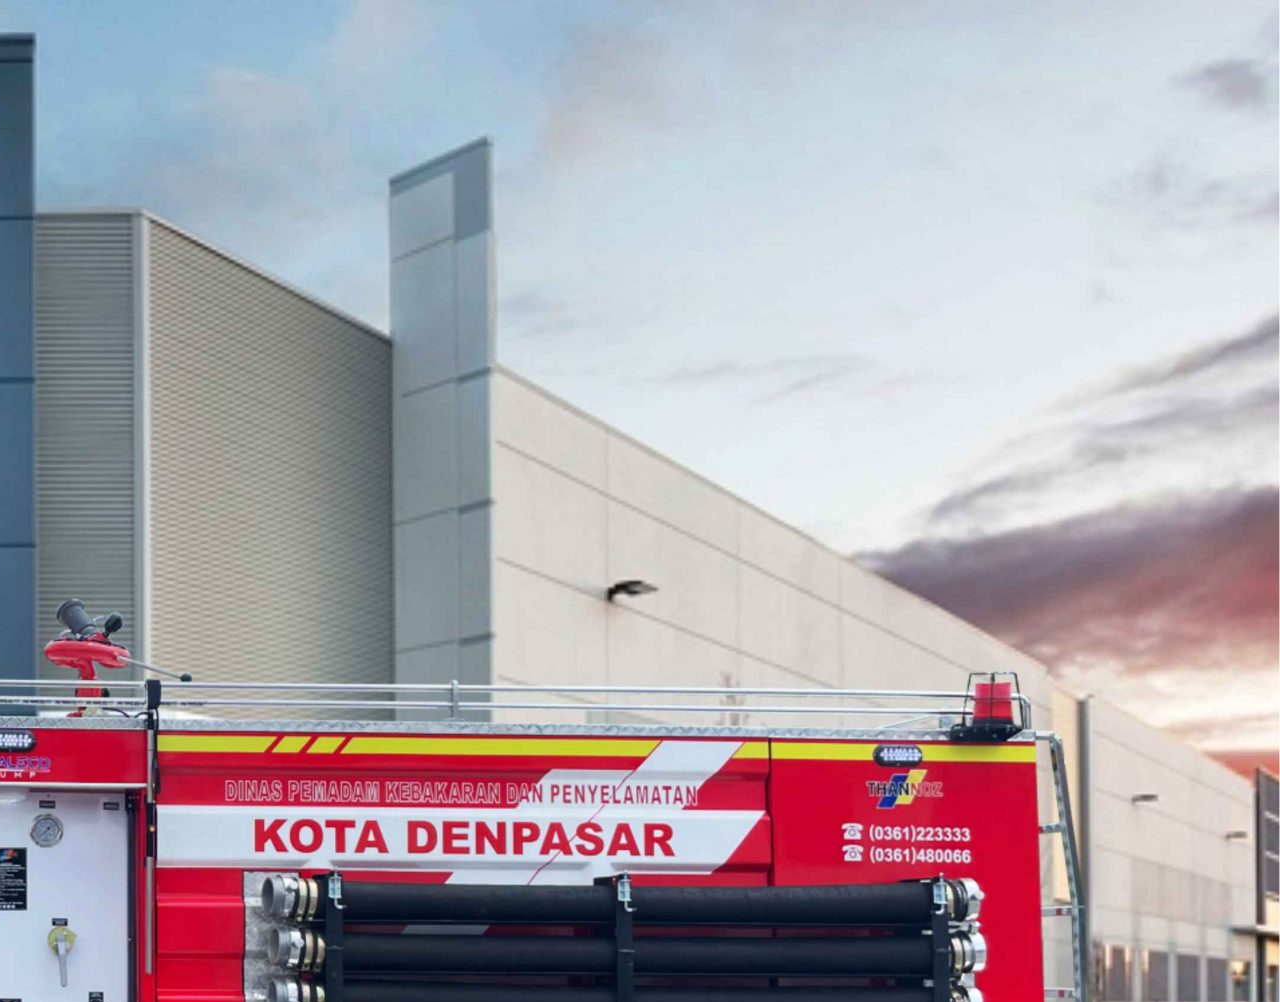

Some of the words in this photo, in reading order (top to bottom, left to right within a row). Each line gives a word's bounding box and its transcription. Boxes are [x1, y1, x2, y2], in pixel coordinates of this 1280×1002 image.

[224, 779, 283, 802] DINAS
[287, 780, 380, 803] PEMADAM
[385, 781, 501, 804] KEBAKARAN
[505, 783, 544, 805] DAN
[550, 784, 698, 806] PENYELAMATAN
[865, 781, 944, 797] THANNOZ
[254, 818, 389, 854] KOTA
[407, 820, 676, 857] DENPASAR
[869, 824, 971, 842] (0361)223333
[870, 846, 972, 864] (0361)480066
